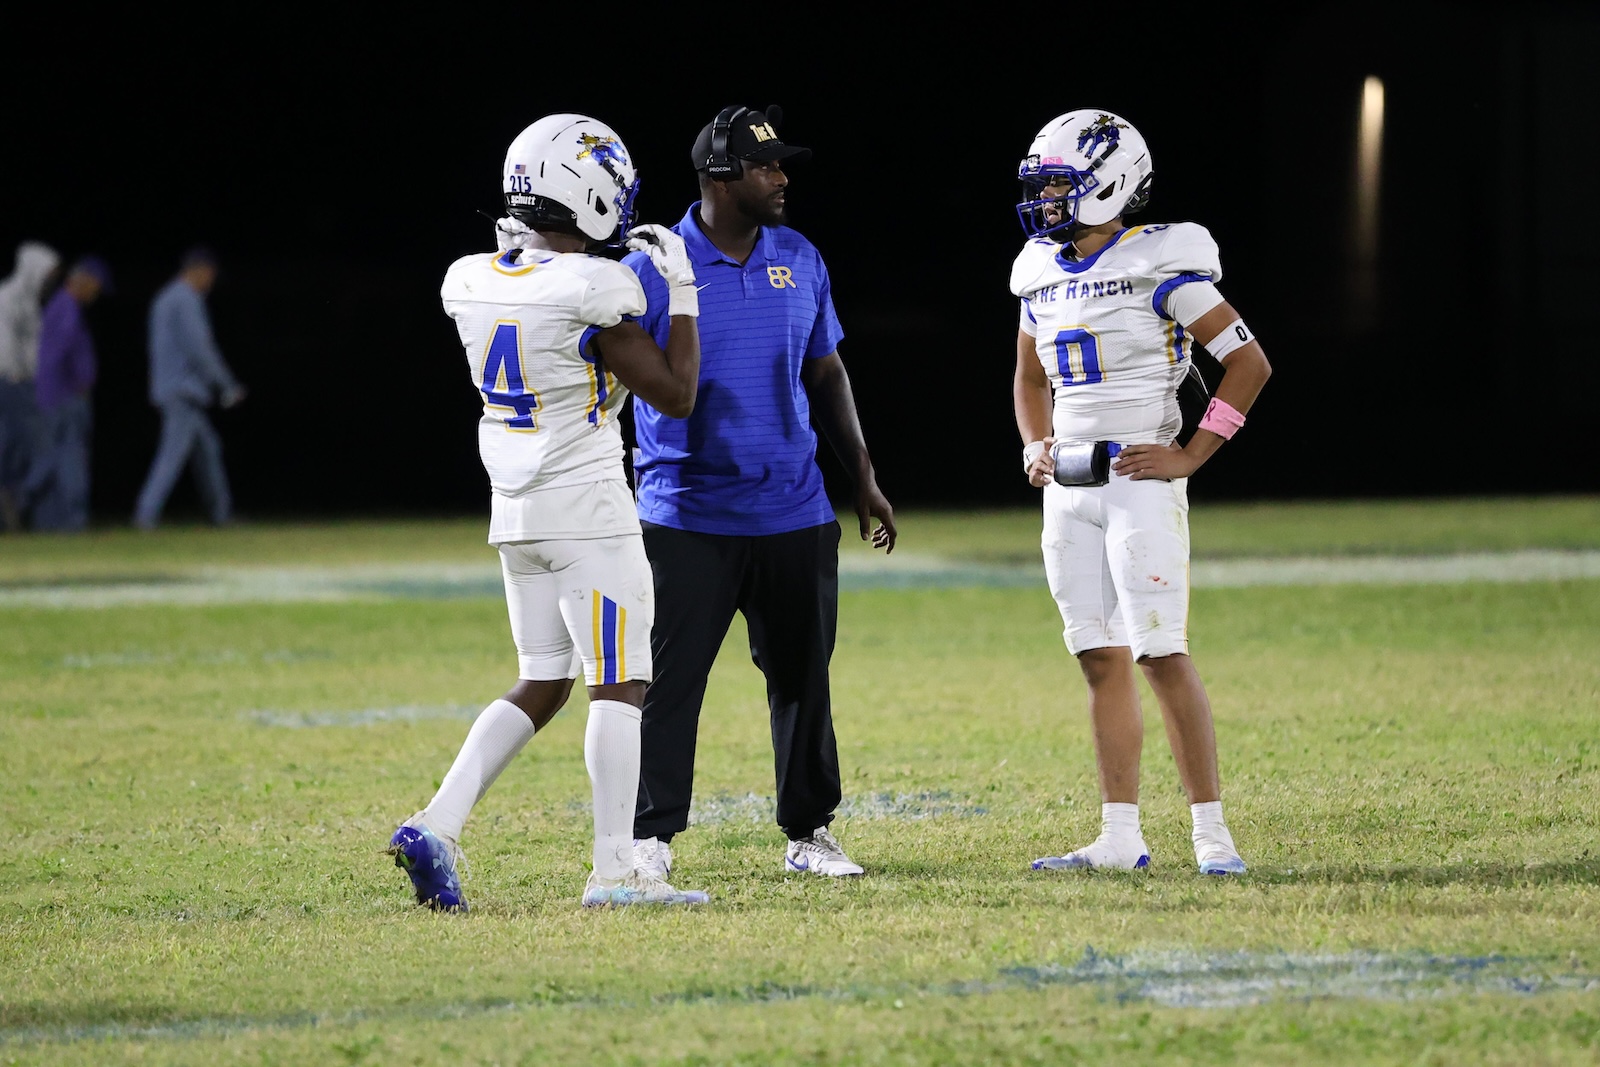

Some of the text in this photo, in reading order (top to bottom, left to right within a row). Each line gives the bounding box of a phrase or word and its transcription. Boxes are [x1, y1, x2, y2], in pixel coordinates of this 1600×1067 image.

[510, 175, 532, 193] 215
[1066, 280, 1133, 299] RANCH
[1235, 325, 1248, 341] 0
[1054, 323, 1108, 387] 0
[480, 319, 543, 433] 4
